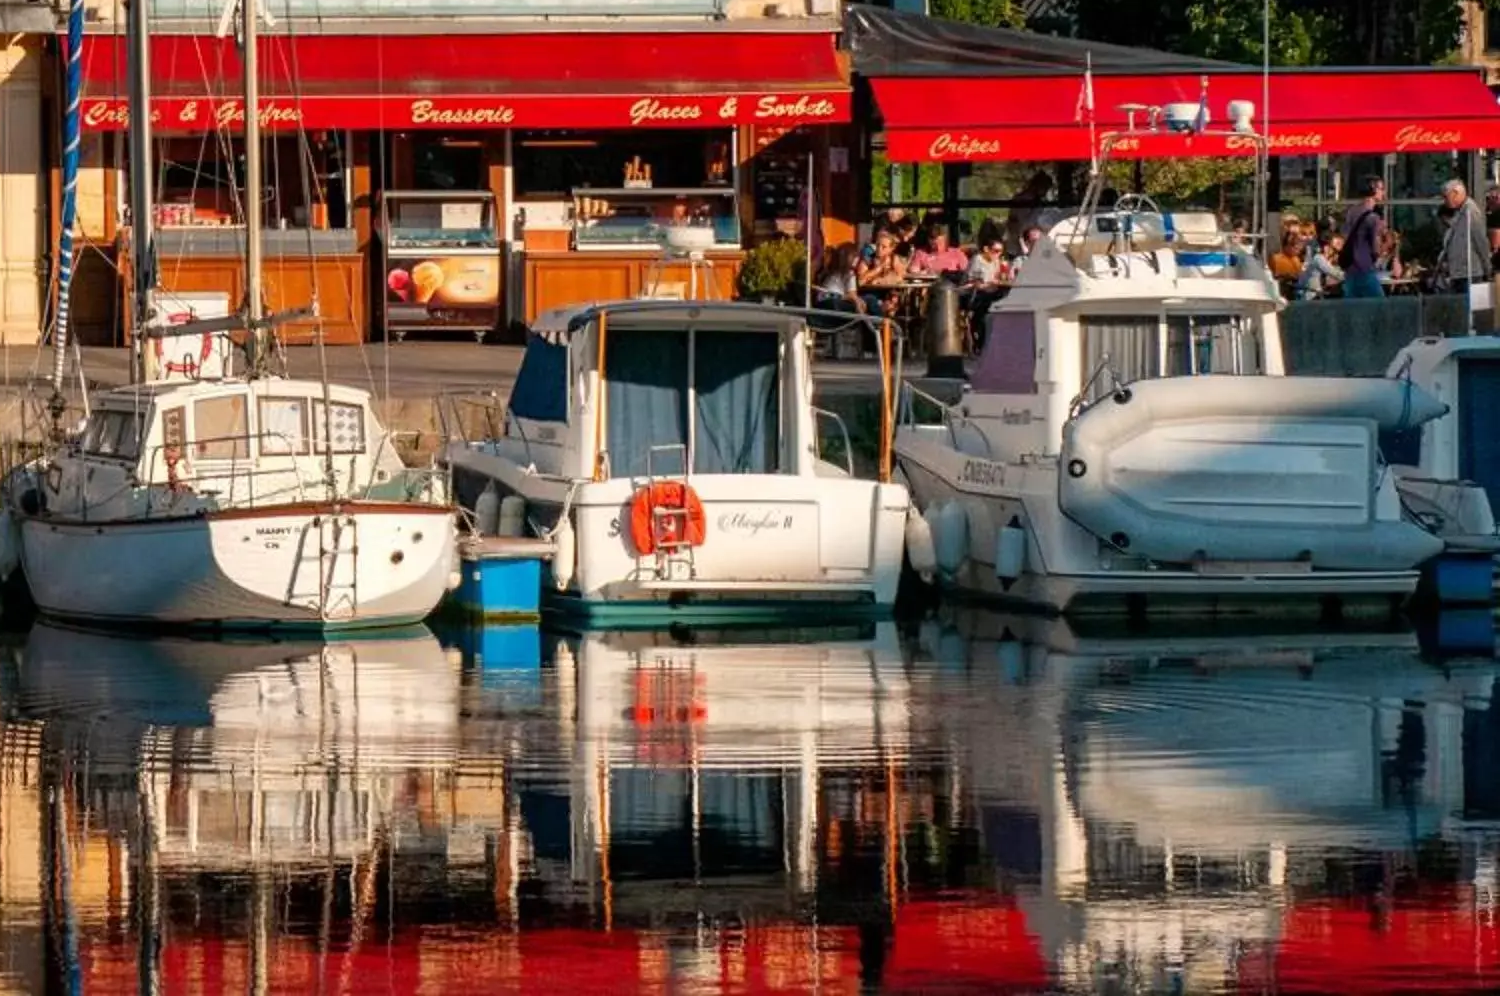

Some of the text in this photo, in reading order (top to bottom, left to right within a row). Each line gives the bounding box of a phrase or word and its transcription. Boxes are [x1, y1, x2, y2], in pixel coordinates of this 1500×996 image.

[85, 101, 303, 128] Crês & Gafres
[411, 100, 515, 123] Brasserie
[629, 96, 836, 124] Glaces & Sorbets
[929, 133, 1000, 158] Crêpes
[1394, 125, 1461, 151] Glaces
